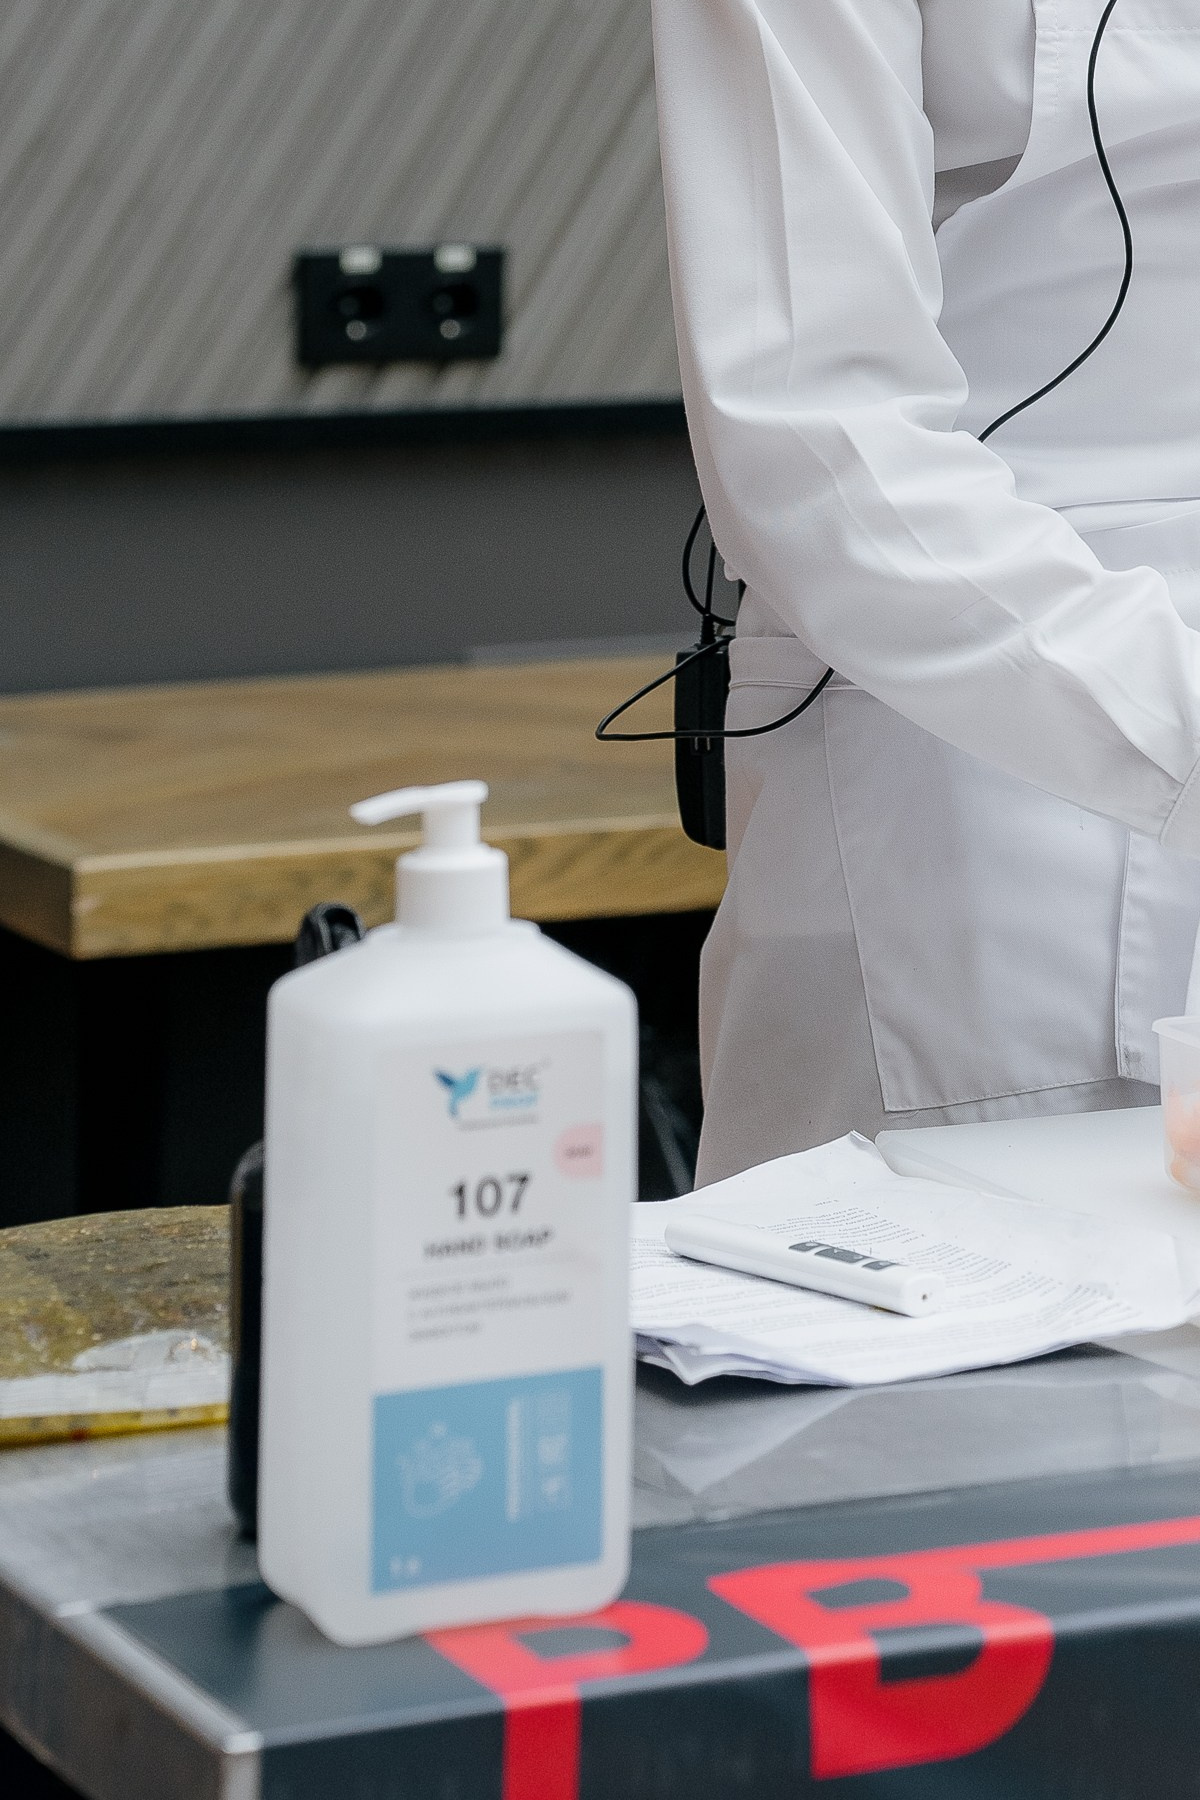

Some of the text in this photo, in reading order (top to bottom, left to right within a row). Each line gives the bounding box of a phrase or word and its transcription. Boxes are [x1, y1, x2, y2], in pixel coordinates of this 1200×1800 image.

[450, 1170, 531, 1221] 107
[423, 1223, 554, 1259] HAND SOAP
